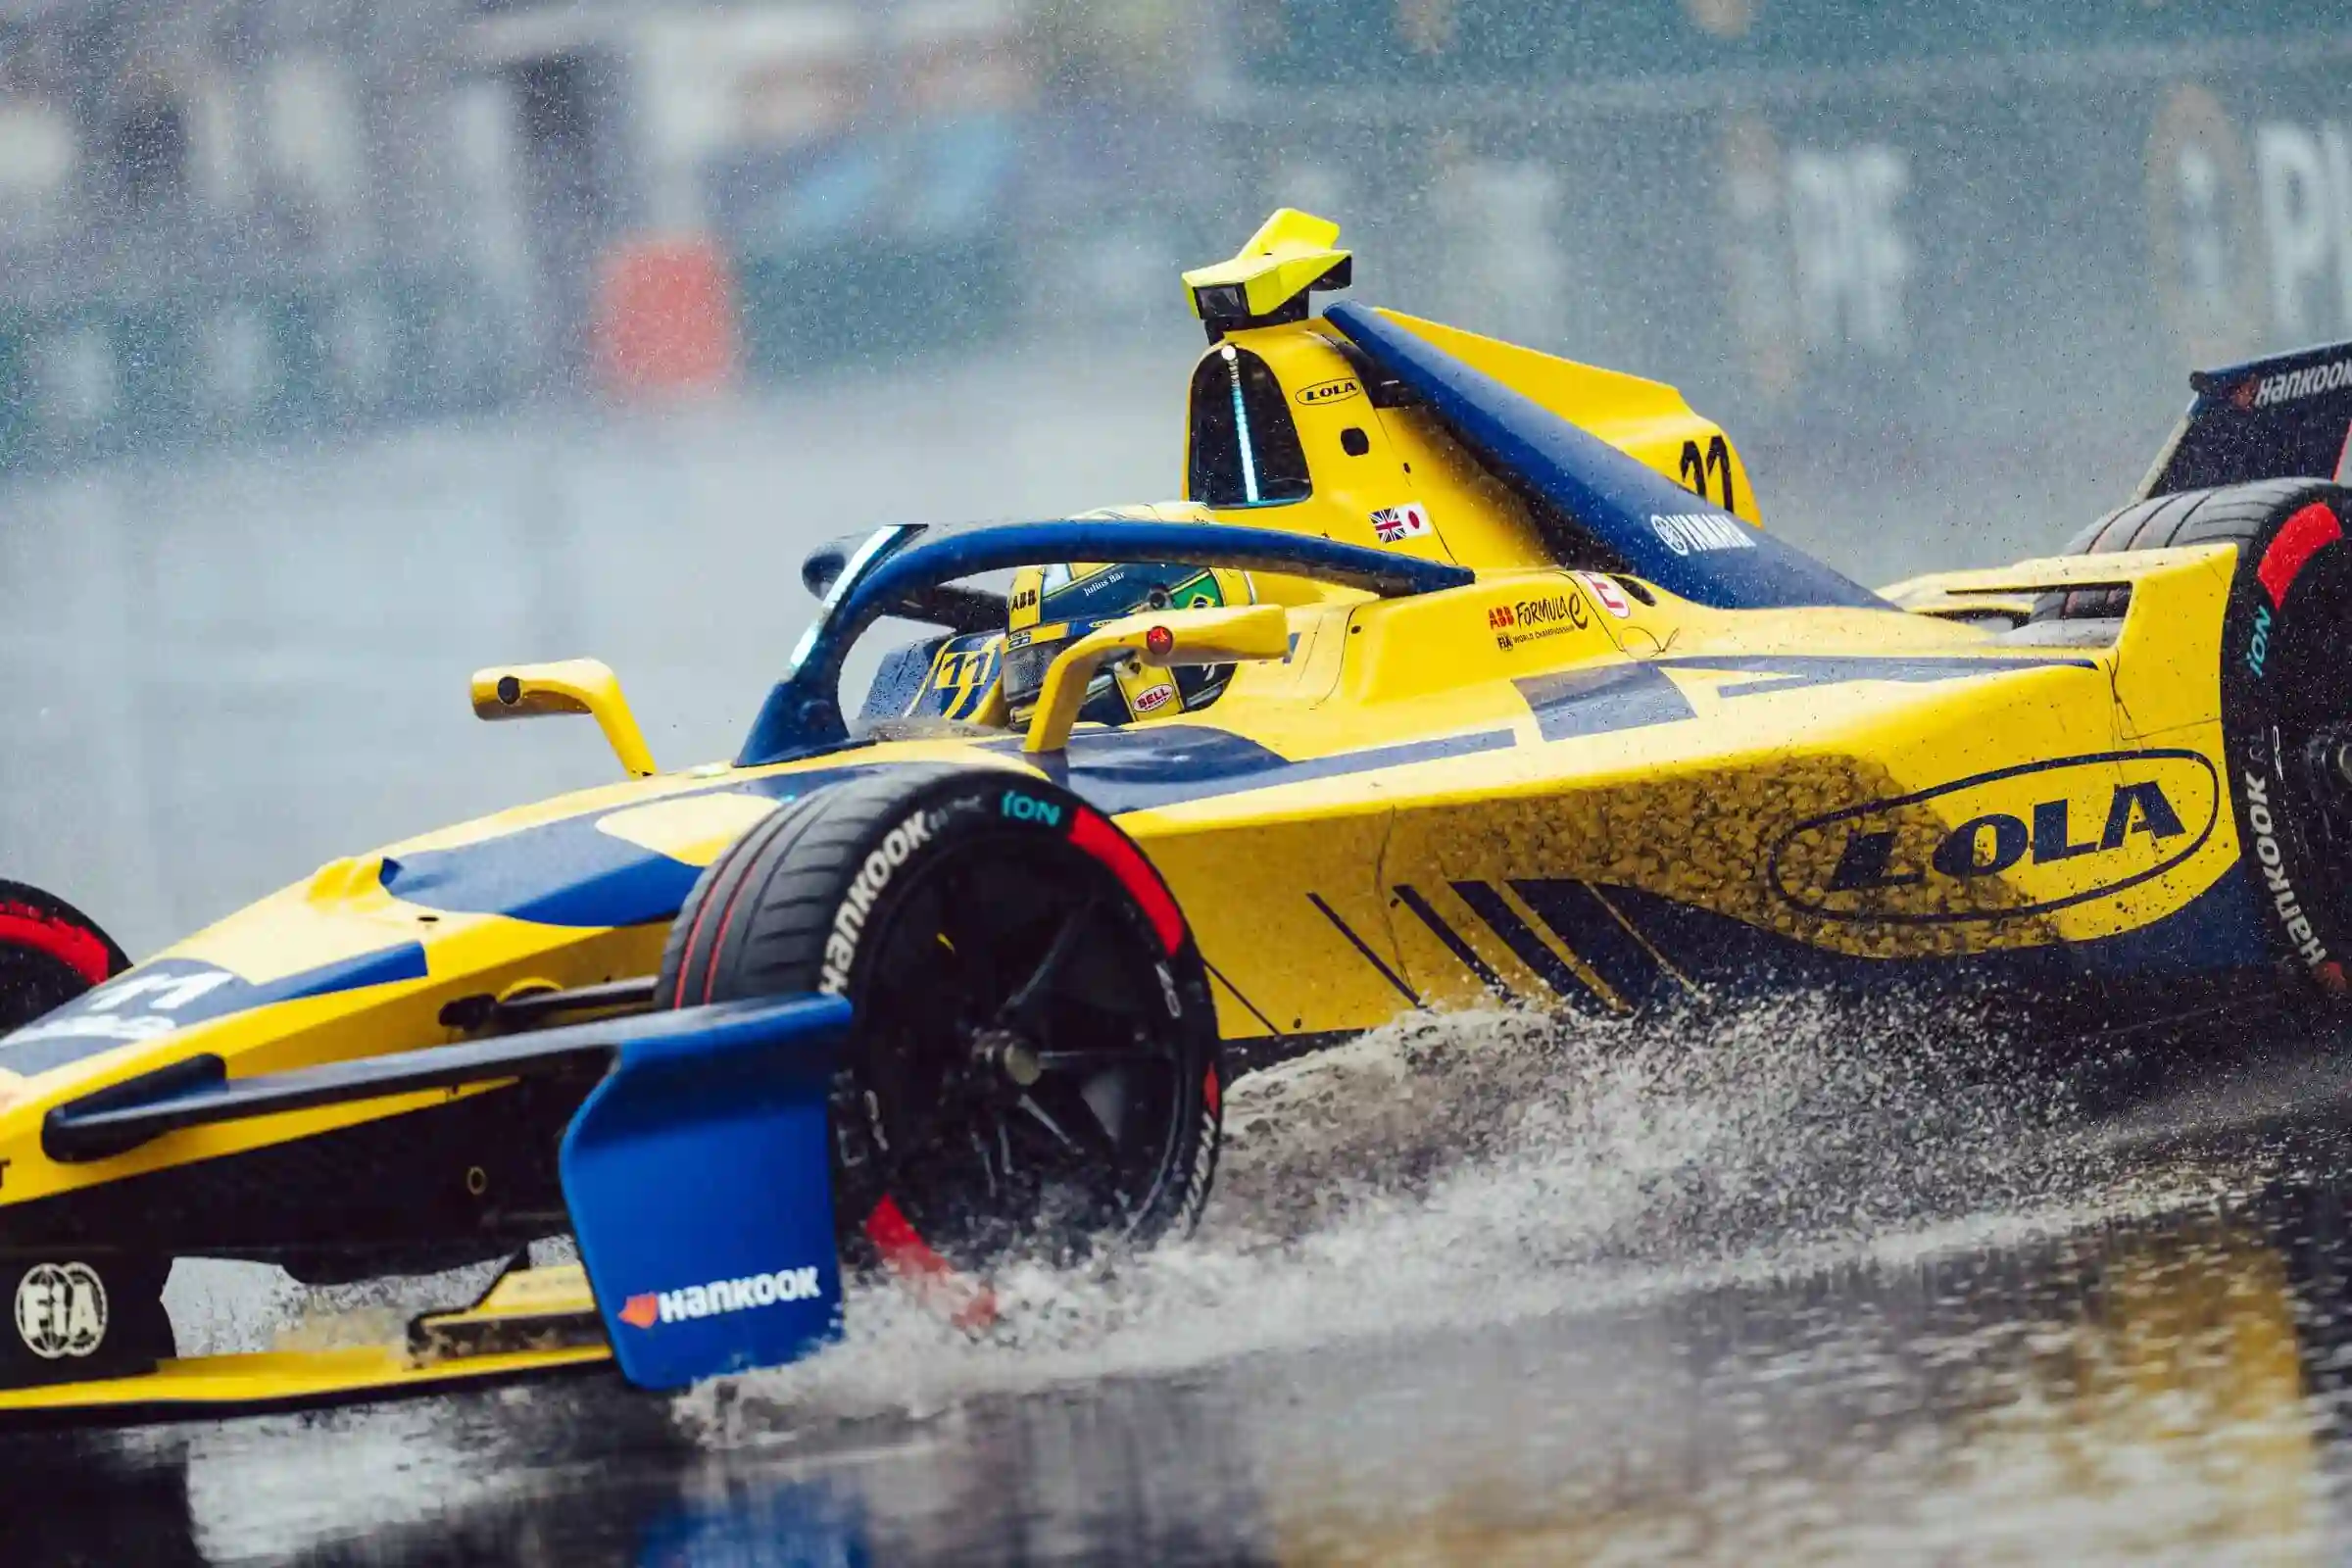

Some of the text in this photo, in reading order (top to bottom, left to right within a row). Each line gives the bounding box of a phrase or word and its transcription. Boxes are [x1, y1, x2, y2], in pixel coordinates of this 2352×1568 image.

[1305, 382, 1357, 401] LOLA
[1011, 589, 1037, 612] ABB
[1488, 606, 1515, 629] ABB
[1137, 687, 1170, 709] BELL
[1824, 781, 2186, 891] LOLA
[20, 1278, 103, 1341] FIA
